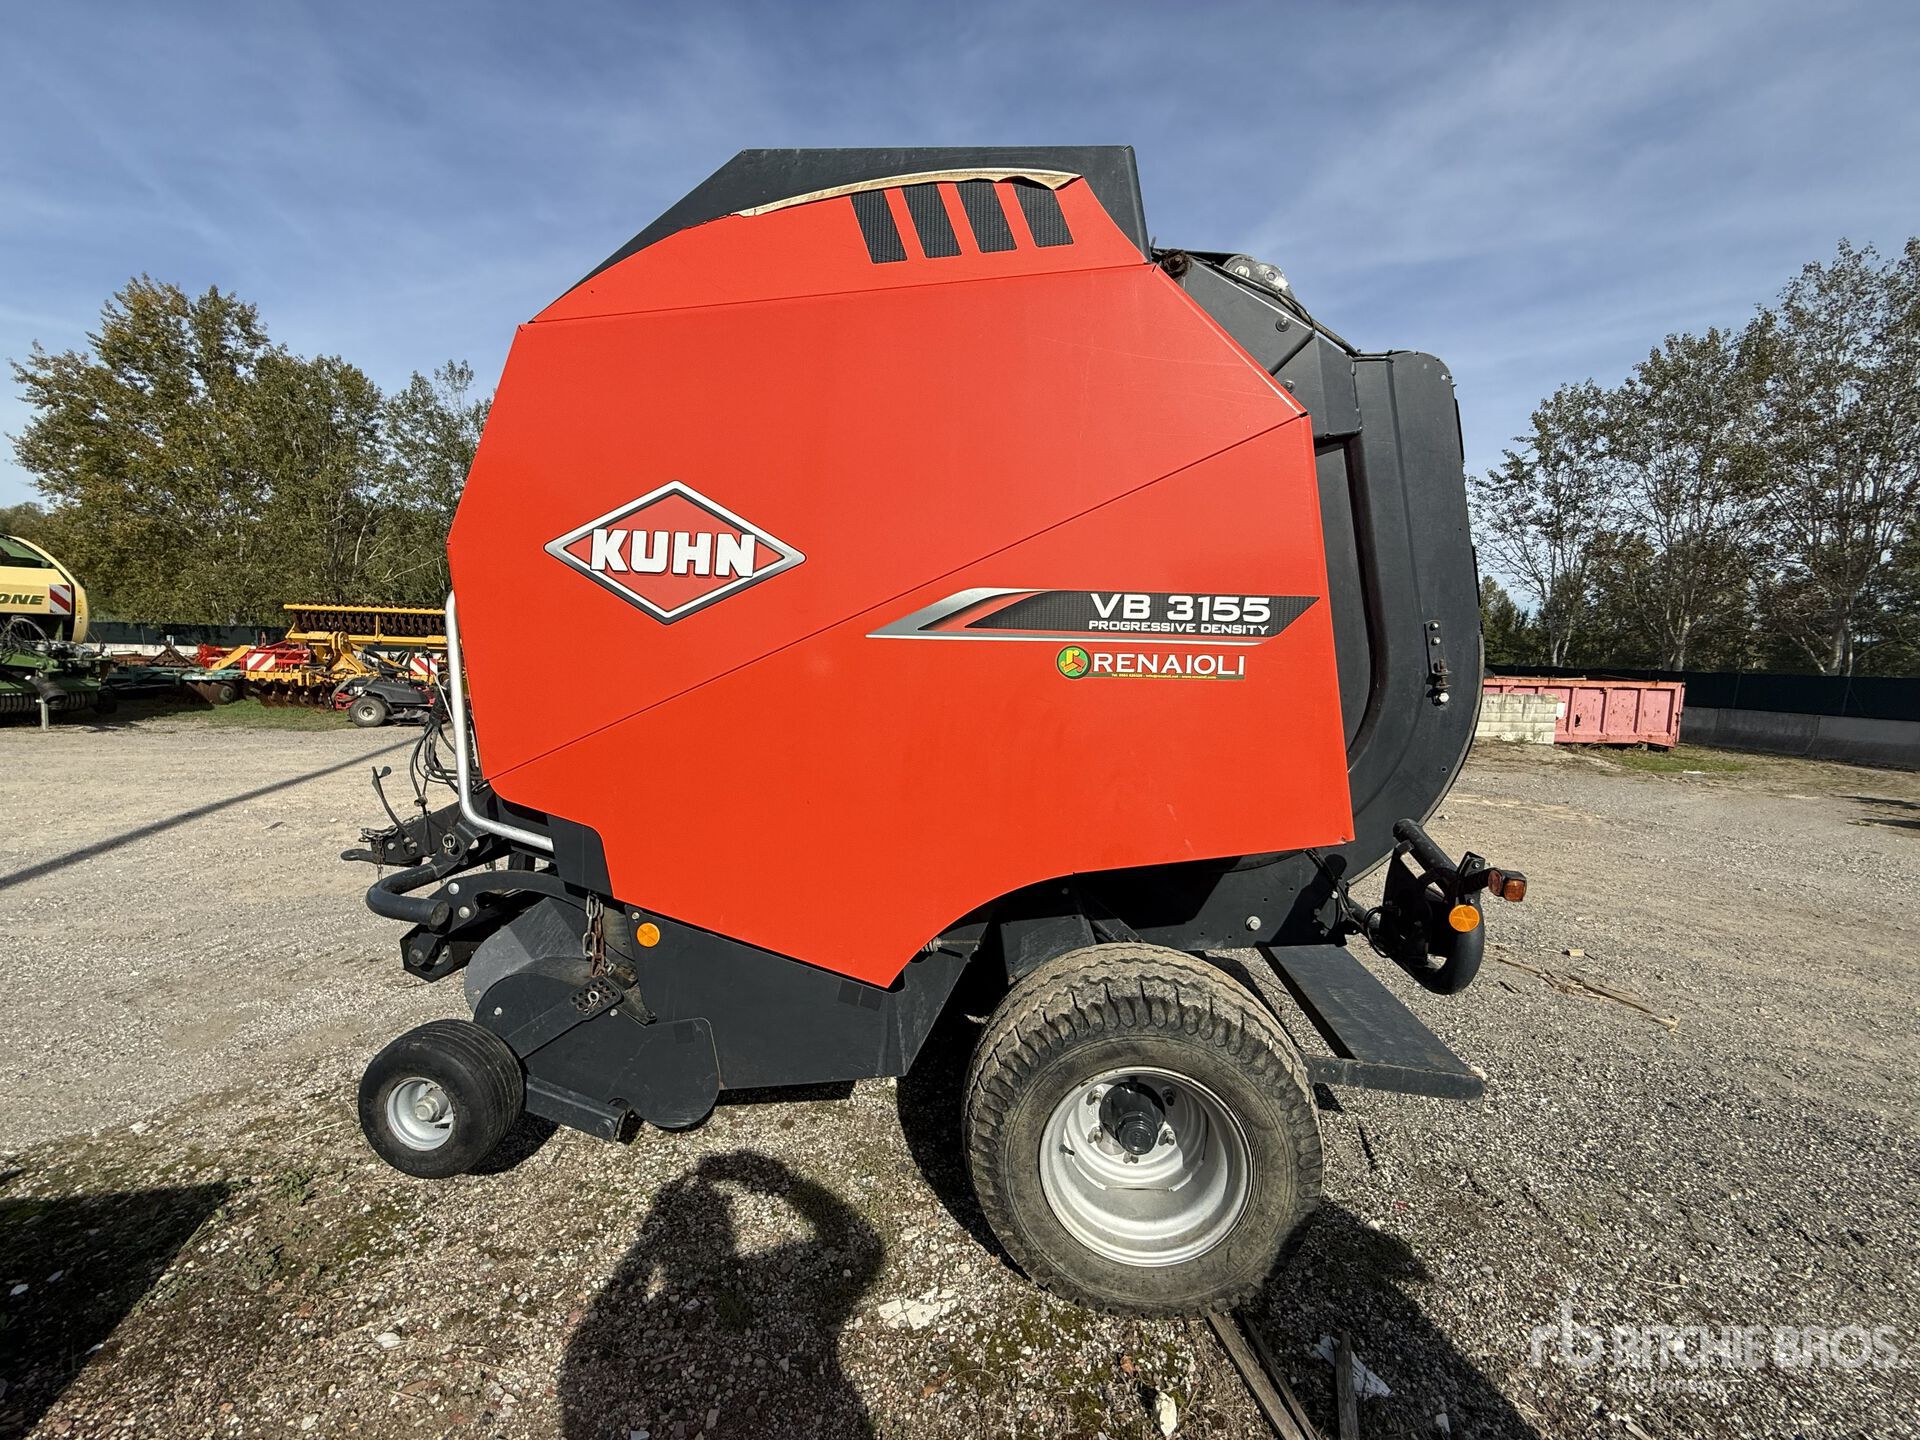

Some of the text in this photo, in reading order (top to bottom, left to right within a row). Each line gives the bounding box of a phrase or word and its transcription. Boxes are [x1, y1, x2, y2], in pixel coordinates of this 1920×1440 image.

[590, 528, 757, 577] KUHN
[1090, 593, 1271, 622] VB 3155
[1089, 620, 1269, 635] PROGRESSIVE DENSITY
[1093, 653, 1246, 675] RENAIOLI
